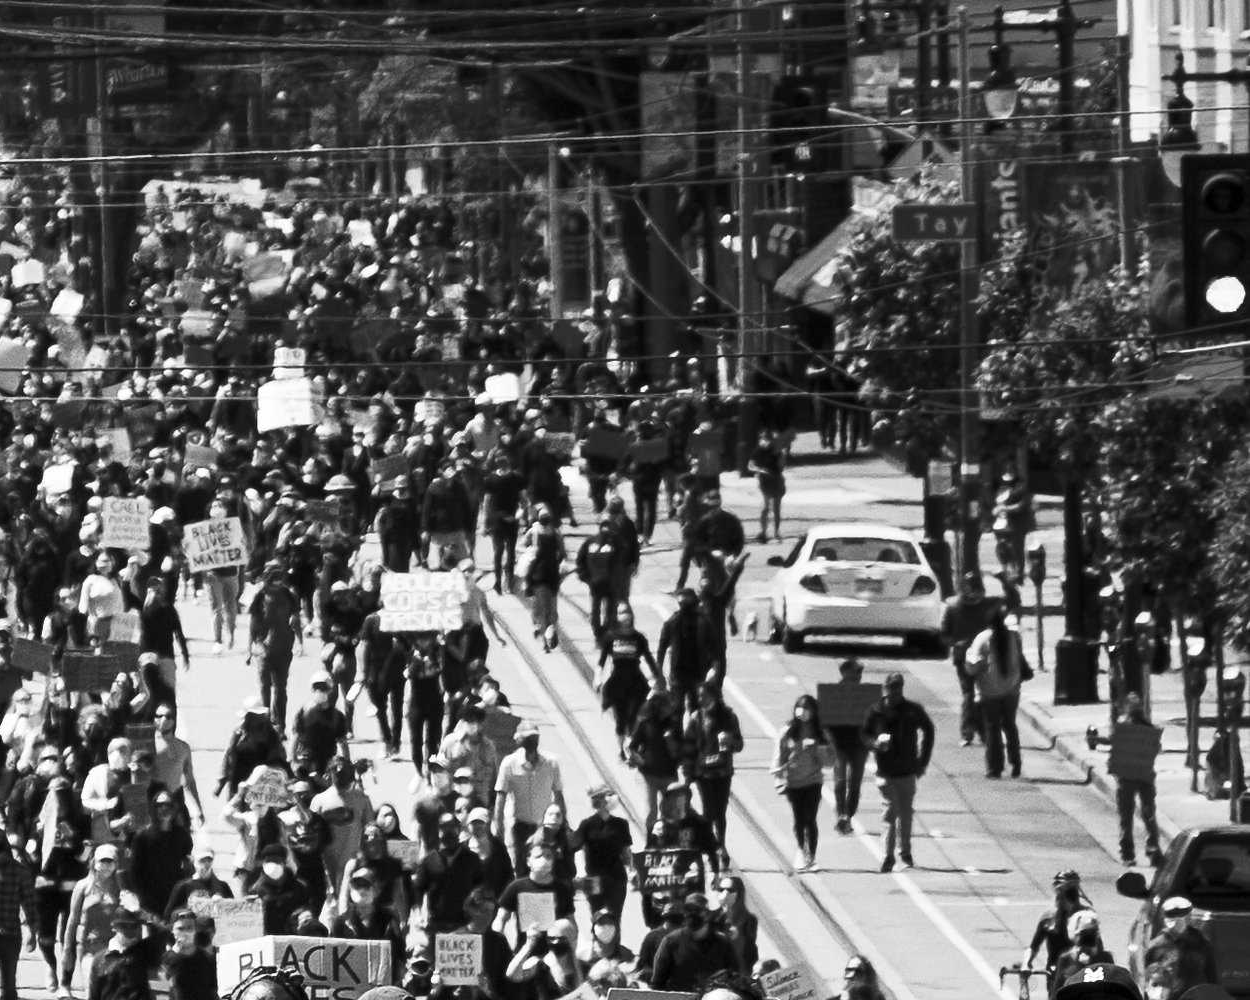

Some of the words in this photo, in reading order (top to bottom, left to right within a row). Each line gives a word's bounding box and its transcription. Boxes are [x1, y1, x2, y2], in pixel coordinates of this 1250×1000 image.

[191, 520, 231, 540] BLACK
[199, 534, 231, 553] LIVES
[193, 548, 242, 567] MATTER
[439, 938, 475, 952] BLACK
[439, 953, 474, 965] LIVES
[440, 966, 476, 978] MATTER
